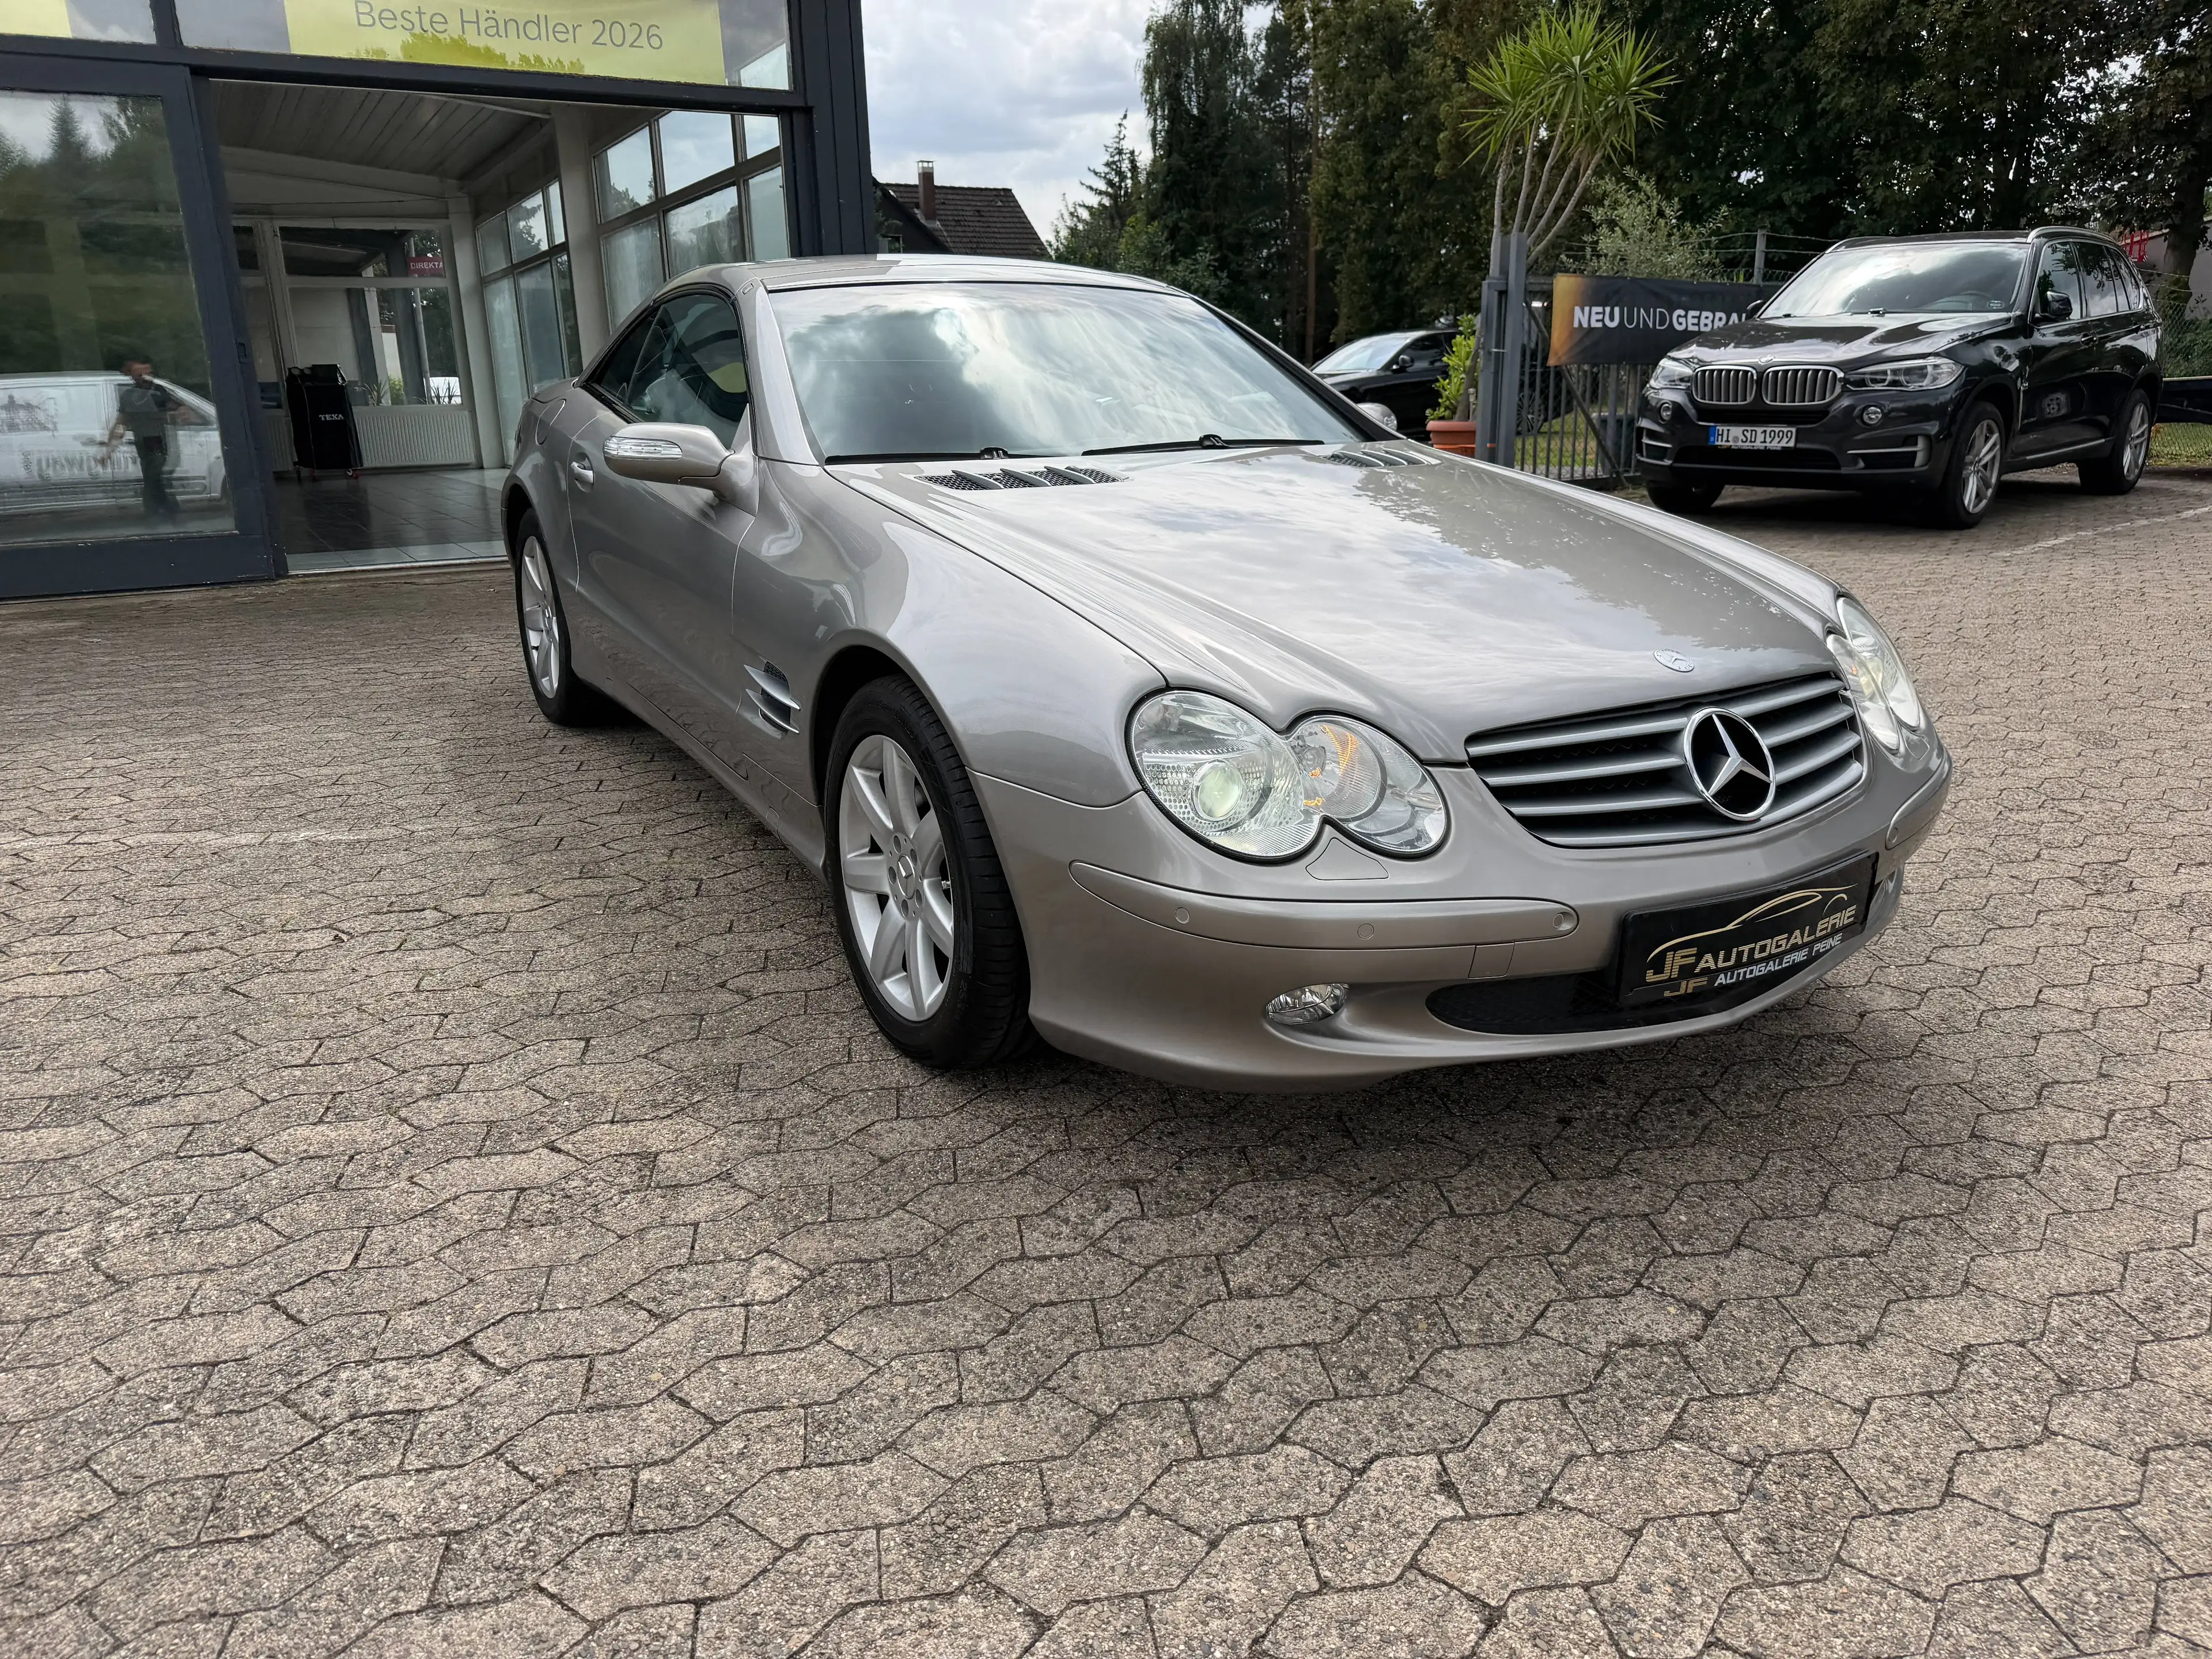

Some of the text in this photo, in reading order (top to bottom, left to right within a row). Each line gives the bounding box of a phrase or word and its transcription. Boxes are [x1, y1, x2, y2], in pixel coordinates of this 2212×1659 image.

[354, 0, 664, 50] Beste Händler 2026
[1573, 306, 1747, 332] NEU UND GEBRA
[1716, 428, 1793, 444] HI SD 1999
[1646, 904, 1857, 983] JF AUTOGALERIE
[1664, 933, 1843, 997] JF AUTOGALERIE PEINE
